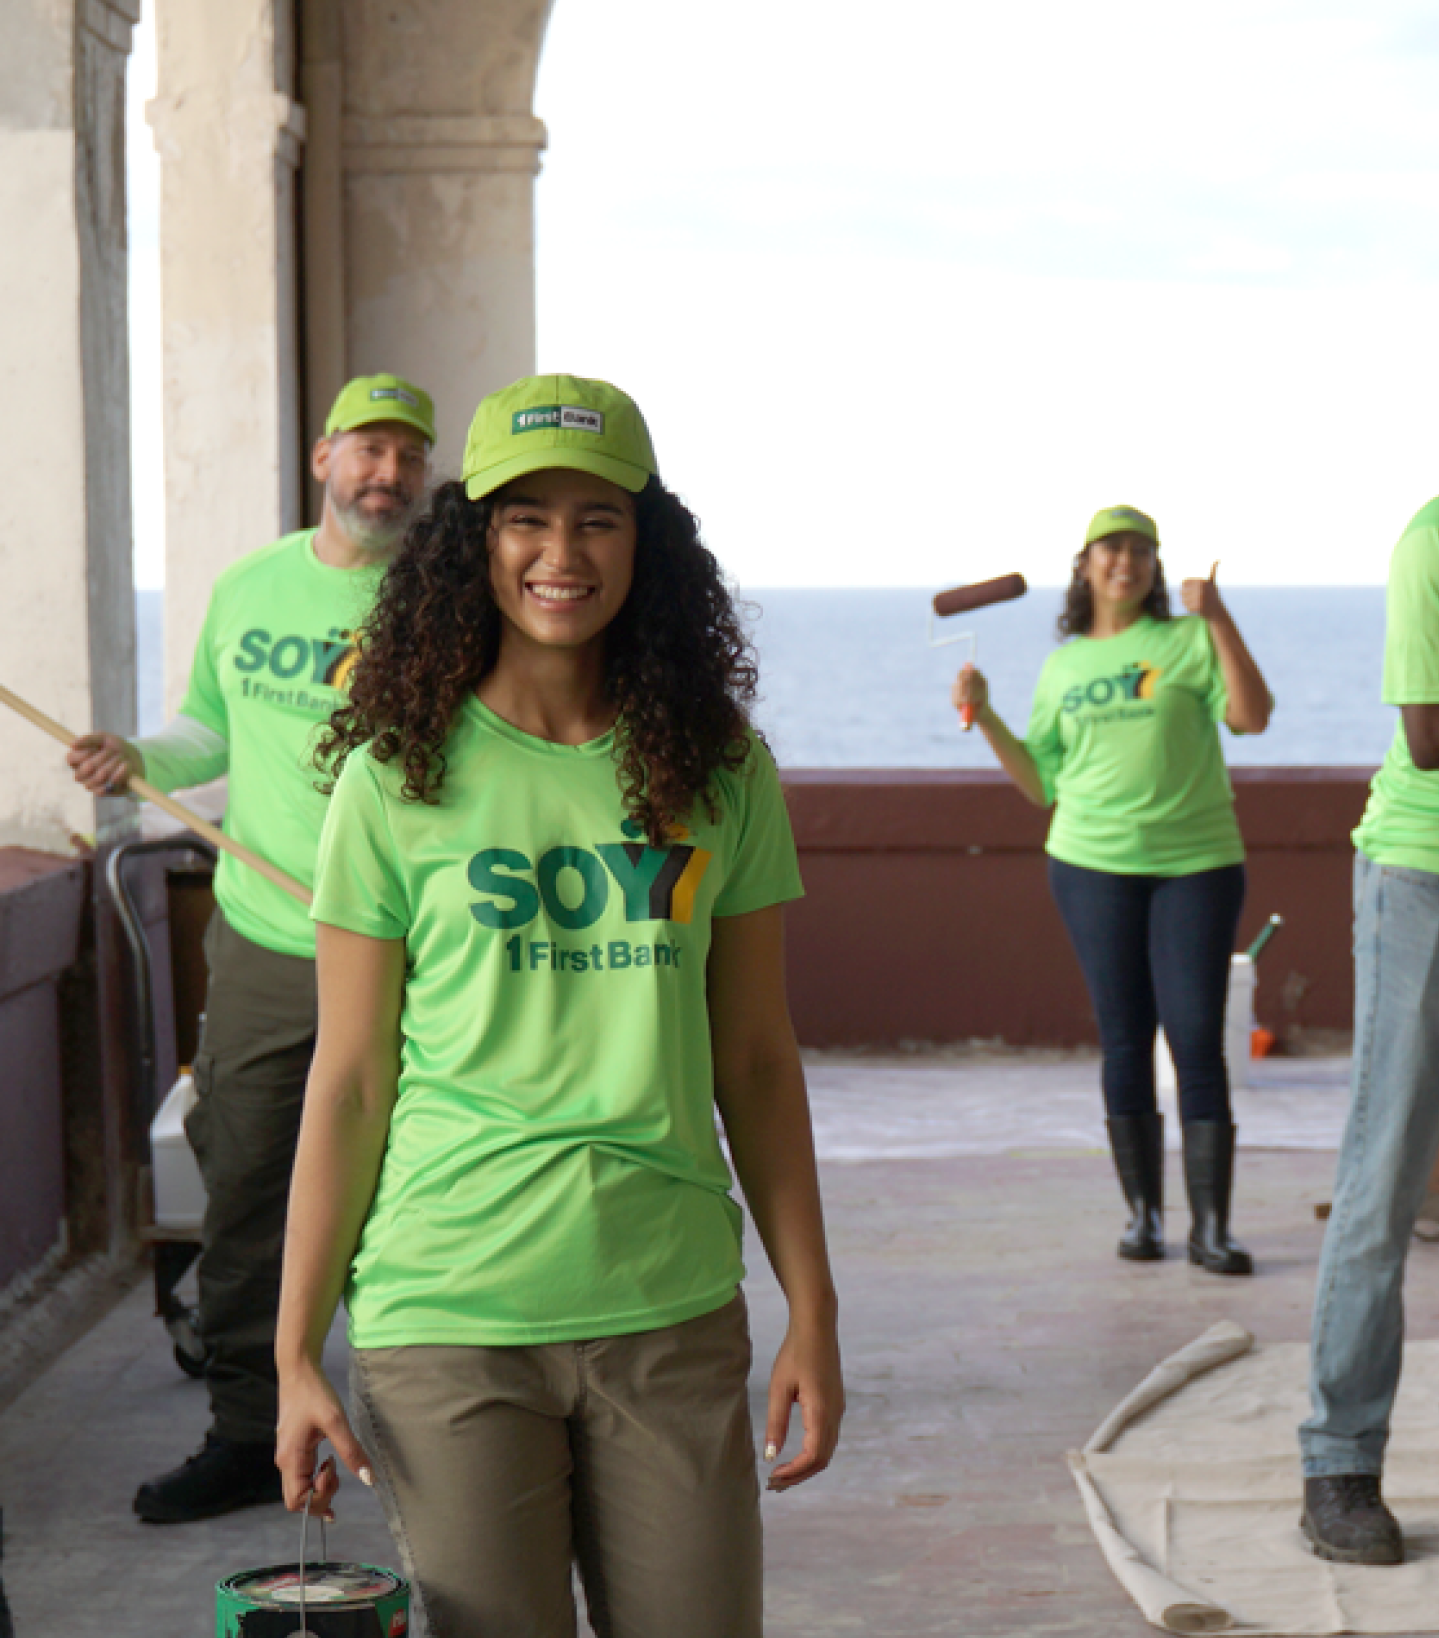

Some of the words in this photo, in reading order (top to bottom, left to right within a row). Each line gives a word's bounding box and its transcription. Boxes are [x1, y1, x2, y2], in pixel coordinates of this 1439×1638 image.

[234, 628, 363, 690] SOY
[1062, 664, 1161, 713] SOY
[467, 841, 713, 931] SOY
